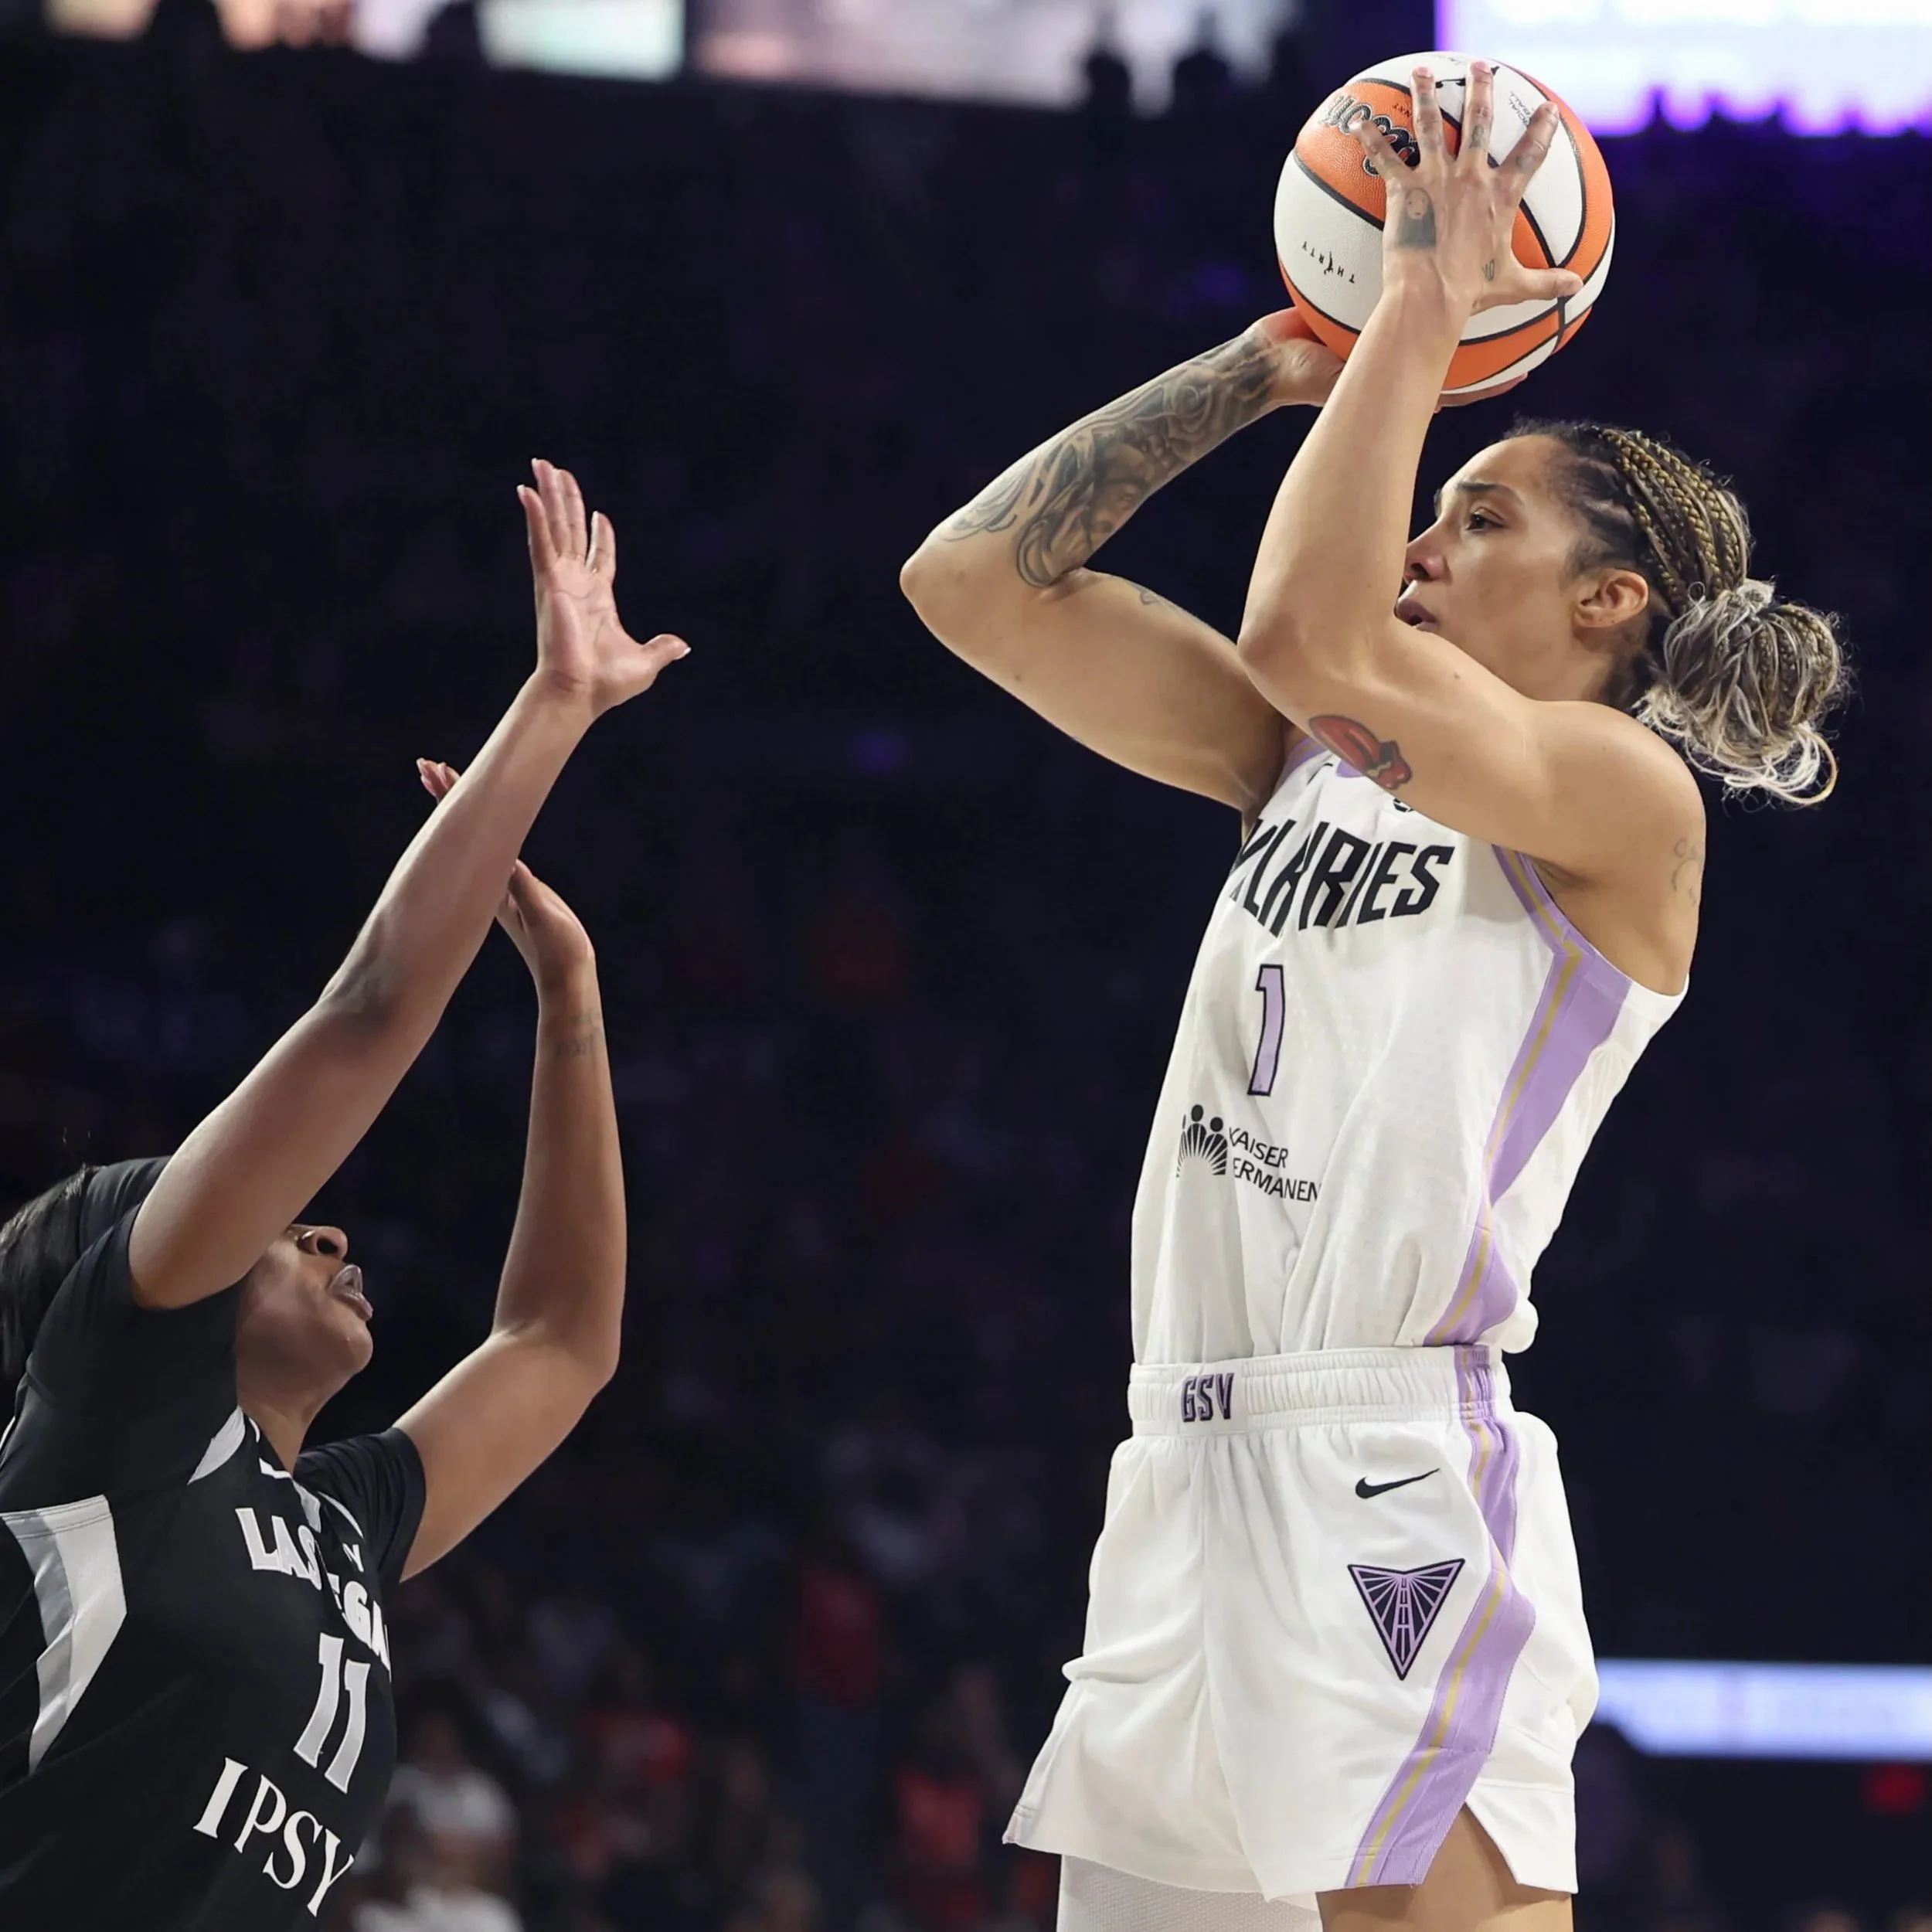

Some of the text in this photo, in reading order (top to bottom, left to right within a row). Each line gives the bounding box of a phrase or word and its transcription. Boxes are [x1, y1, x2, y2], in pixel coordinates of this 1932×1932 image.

[1247, 964, 1285, 1097] 1
[1229, 1127, 1288, 1168] KAISER
[1233, 1157, 1321, 1202] ERMANEN
[1181, 1372, 1235, 1423] GSV
[235, 1507, 322, 1590] LAS
[294, 1632, 371, 1794] 11
[192, 1757, 355, 1917] IPSY
